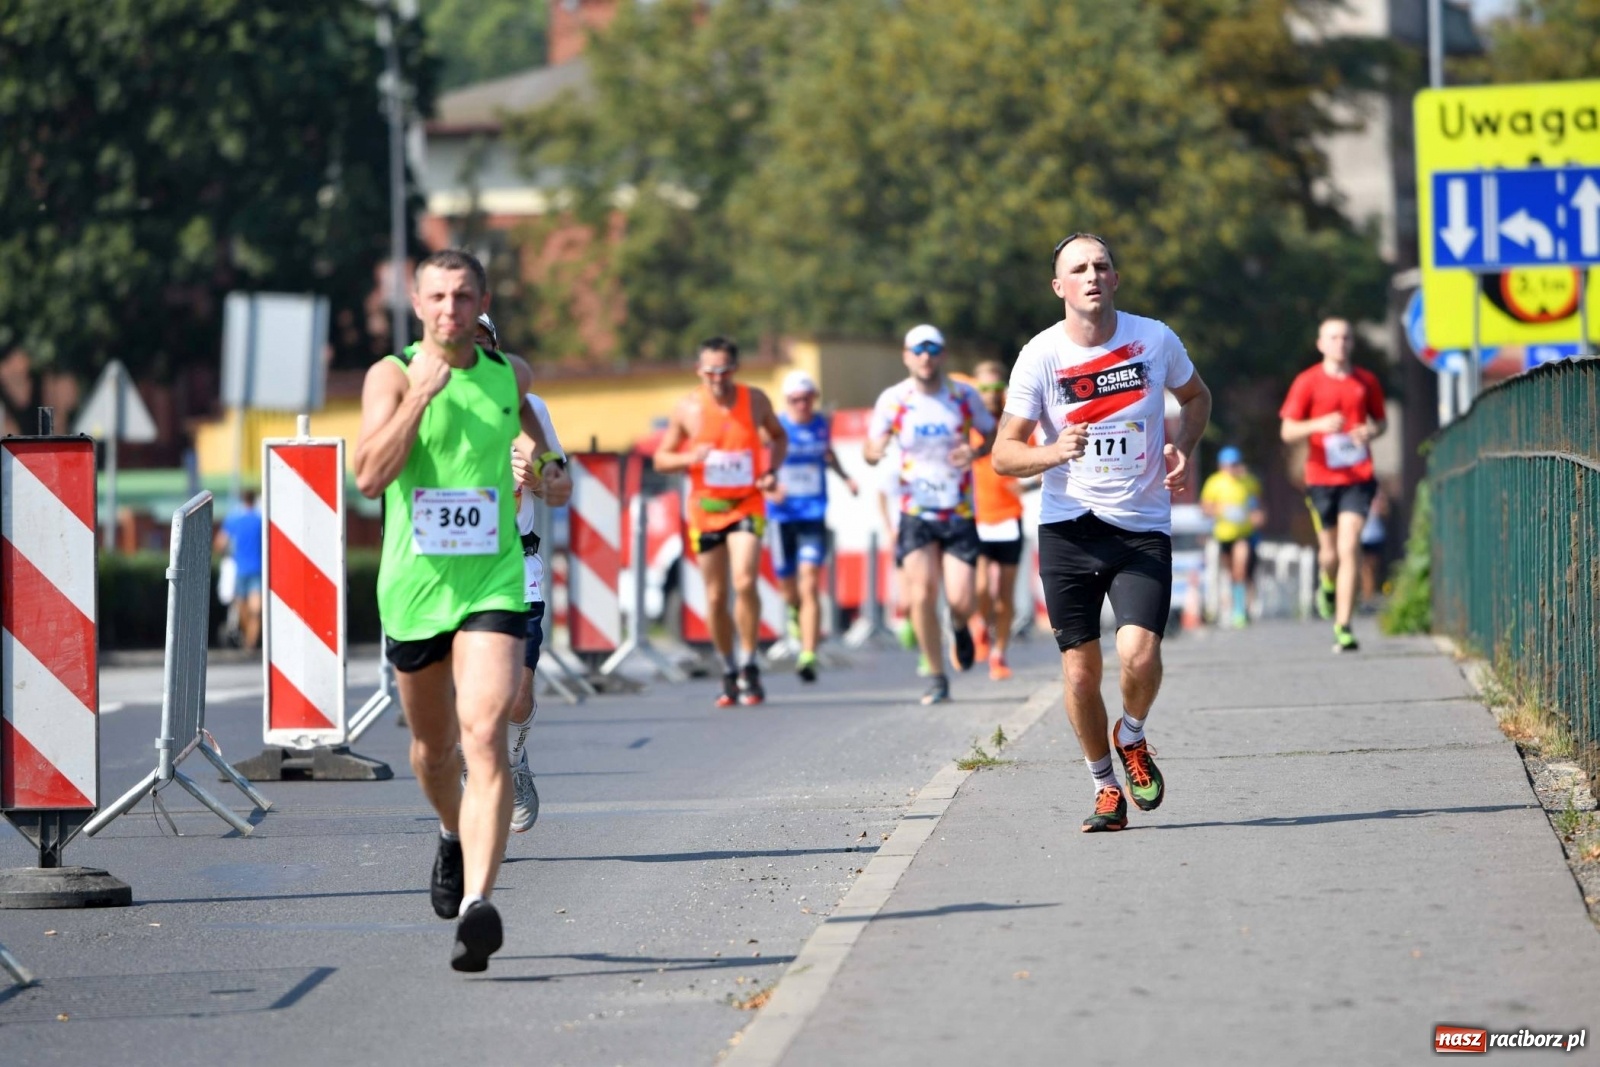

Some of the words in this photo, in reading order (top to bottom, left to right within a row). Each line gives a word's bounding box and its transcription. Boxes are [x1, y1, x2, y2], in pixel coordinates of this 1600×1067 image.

[1439, 102, 1598, 146] Uwaga
[1096, 367, 1139, 386] OSIEK
[1097, 379, 1141, 394] TRIATHLON
[1094, 437, 1127, 456] 171
[439, 506, 481, 528] 360
